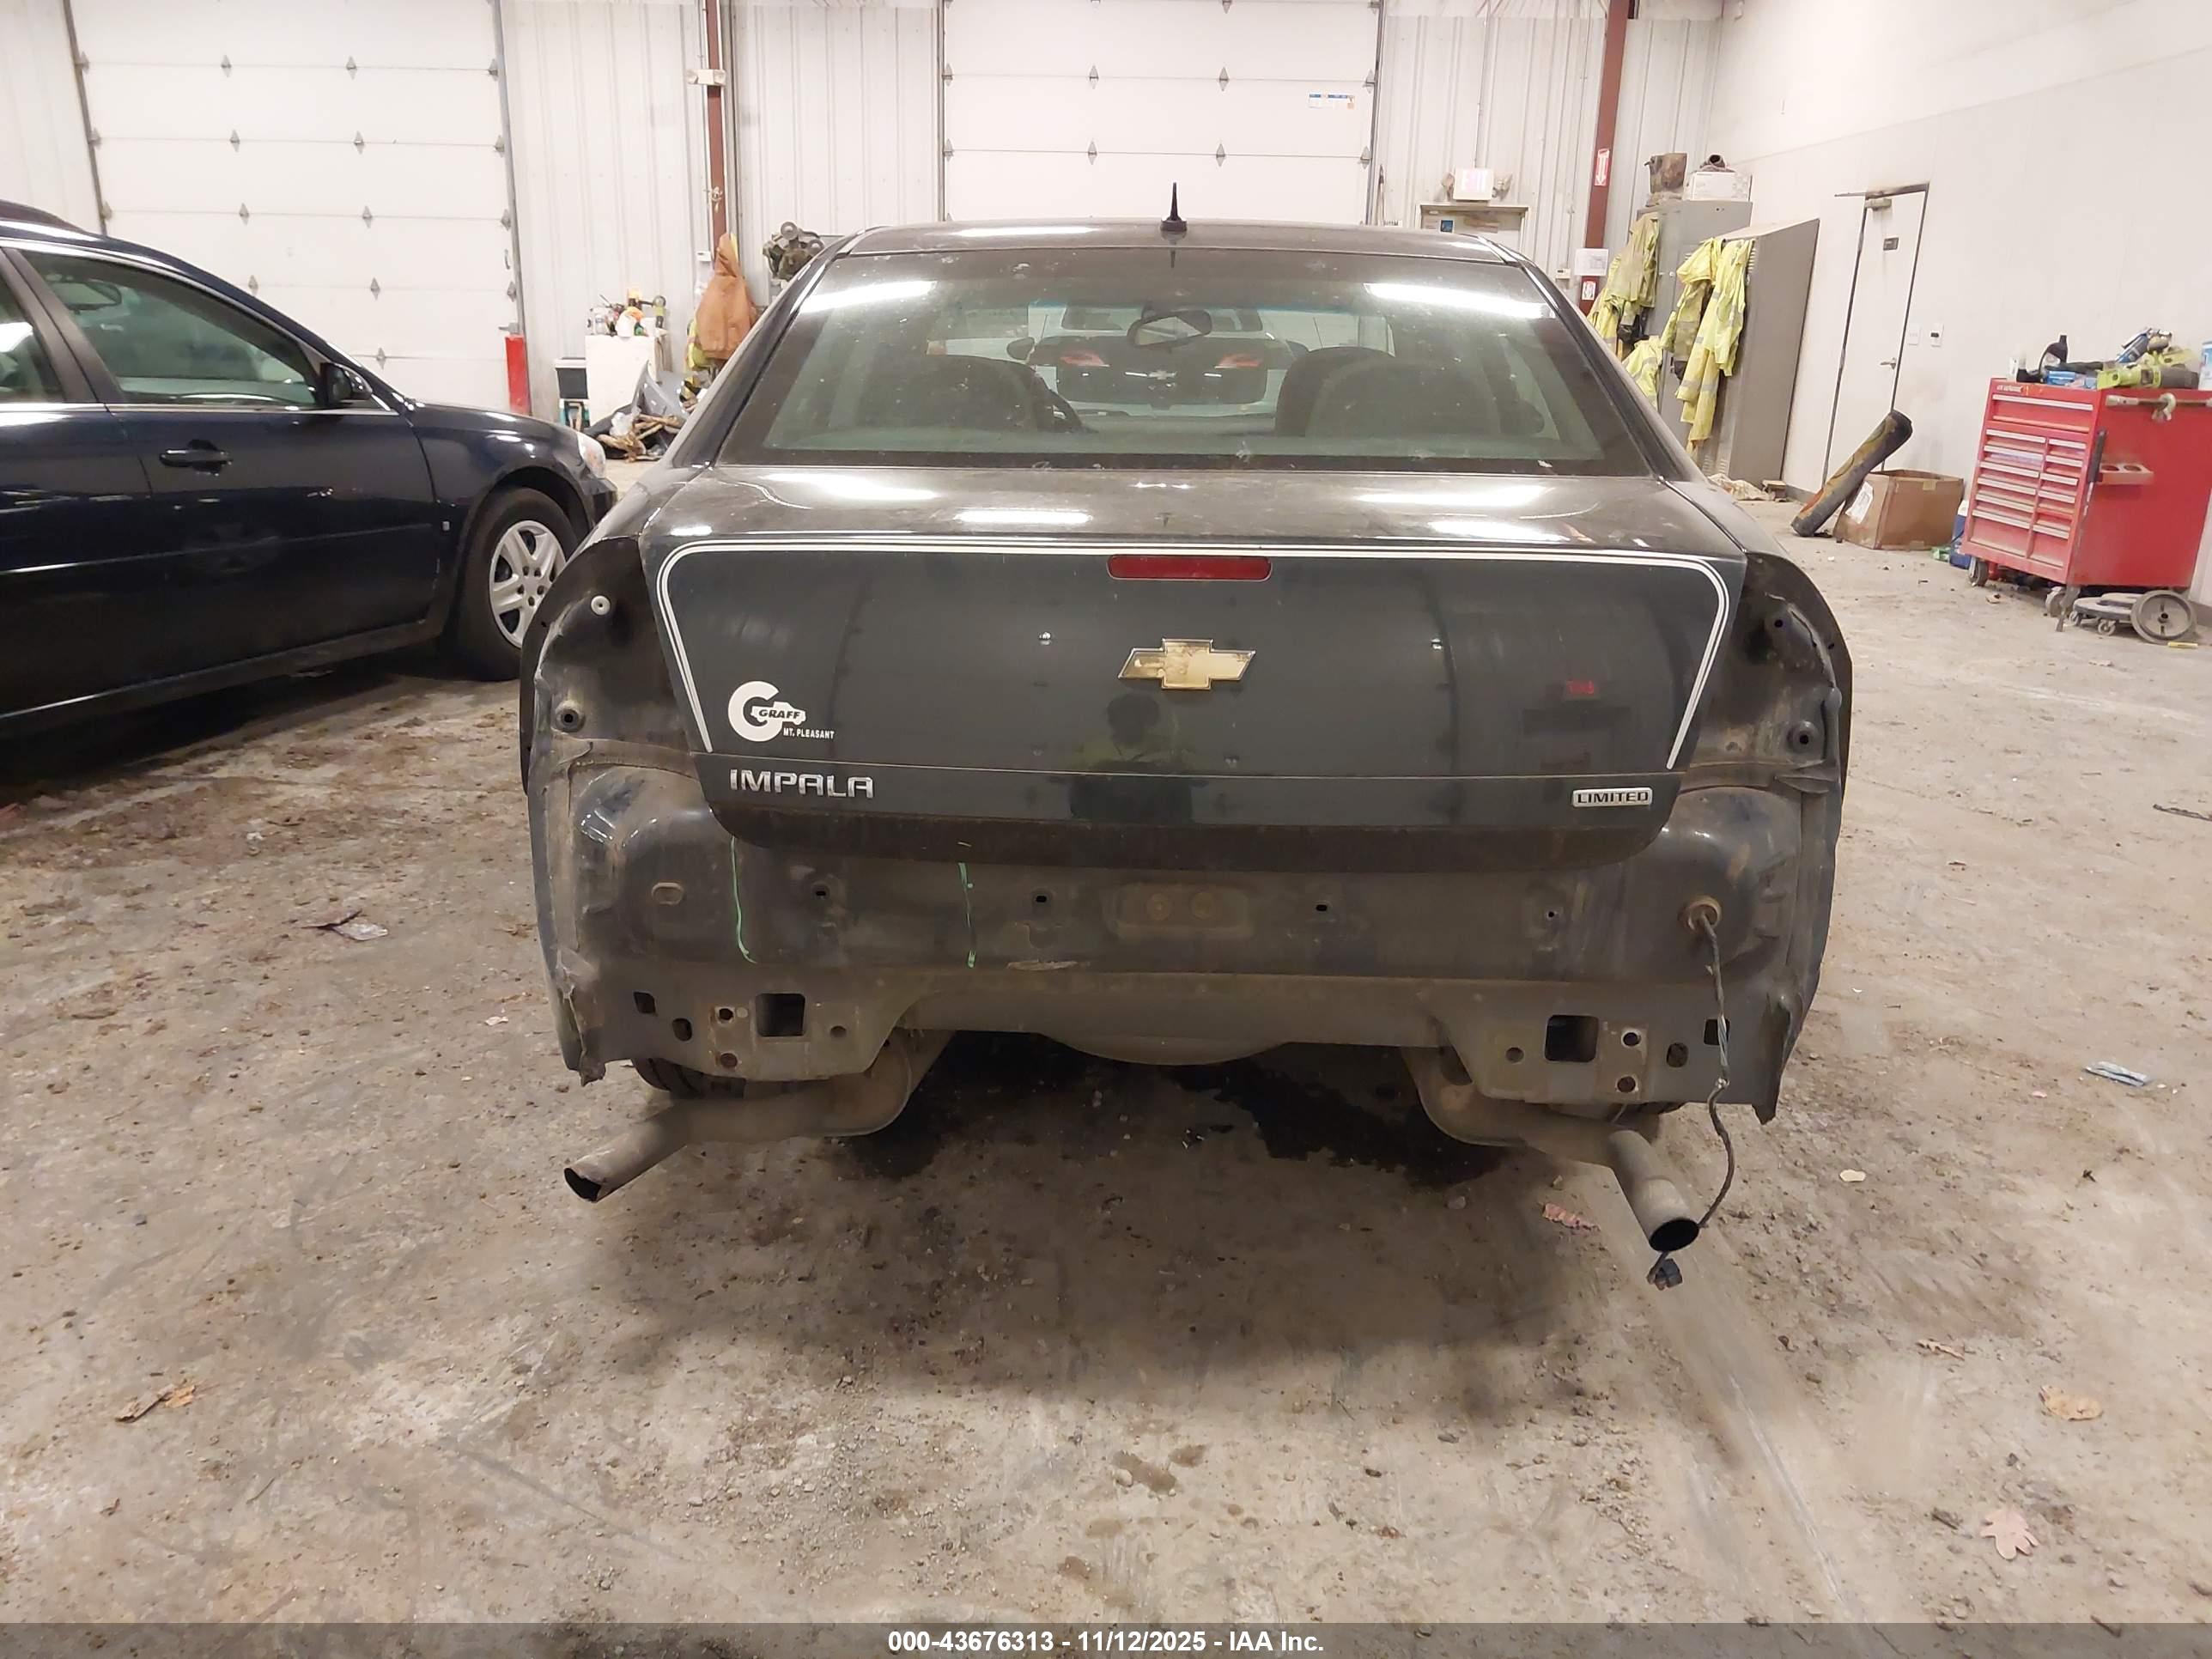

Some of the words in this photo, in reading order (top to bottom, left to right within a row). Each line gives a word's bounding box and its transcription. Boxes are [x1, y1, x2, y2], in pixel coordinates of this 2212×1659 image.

[758, 708, 800, 720] GRAFF
[783, 727, 795, 738] MT.
[797, 728, 835, 739] PLEASANT
[730, 769, 874, 799] IMPALA
[1577, 791, 1649, 804] LIMITED
